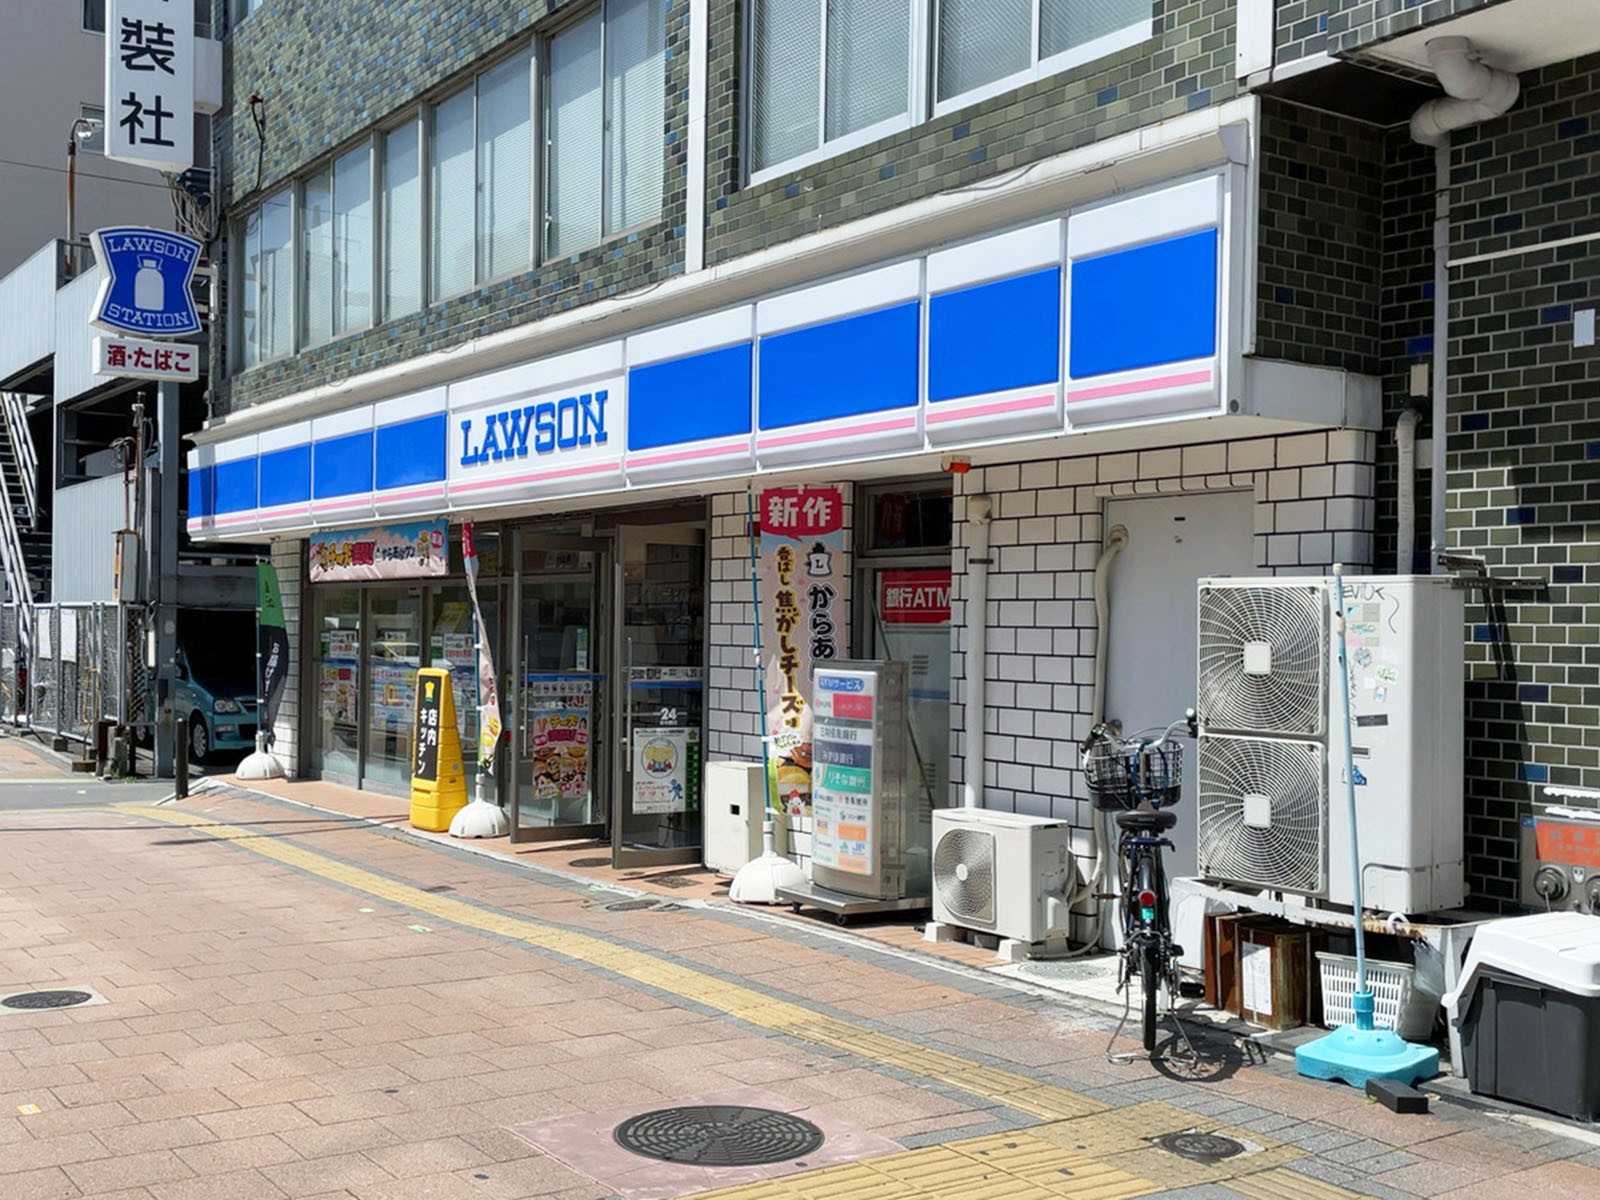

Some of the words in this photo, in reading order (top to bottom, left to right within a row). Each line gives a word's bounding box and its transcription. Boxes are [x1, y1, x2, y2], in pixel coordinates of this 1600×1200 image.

[120, 0, 175, 148] 装社
[107, 238, 193, 262] LAWSON
[107, 304, 190, 326] STATION
[107, 344, 191, 373] 酒・たばこ
[460, 390, 609, 466] LAWSON
[768, 496, 833, 527] 新作
[885, 587, 951, 608] 銀行ATM
[808, 585, 836, 660] からあ
[427, 709, 438, 746] 店内
[660, 708, 677, 720] 24
[418, 708, 428, 775] キッチン
[828, 772, 866, 788] りそな銀行
